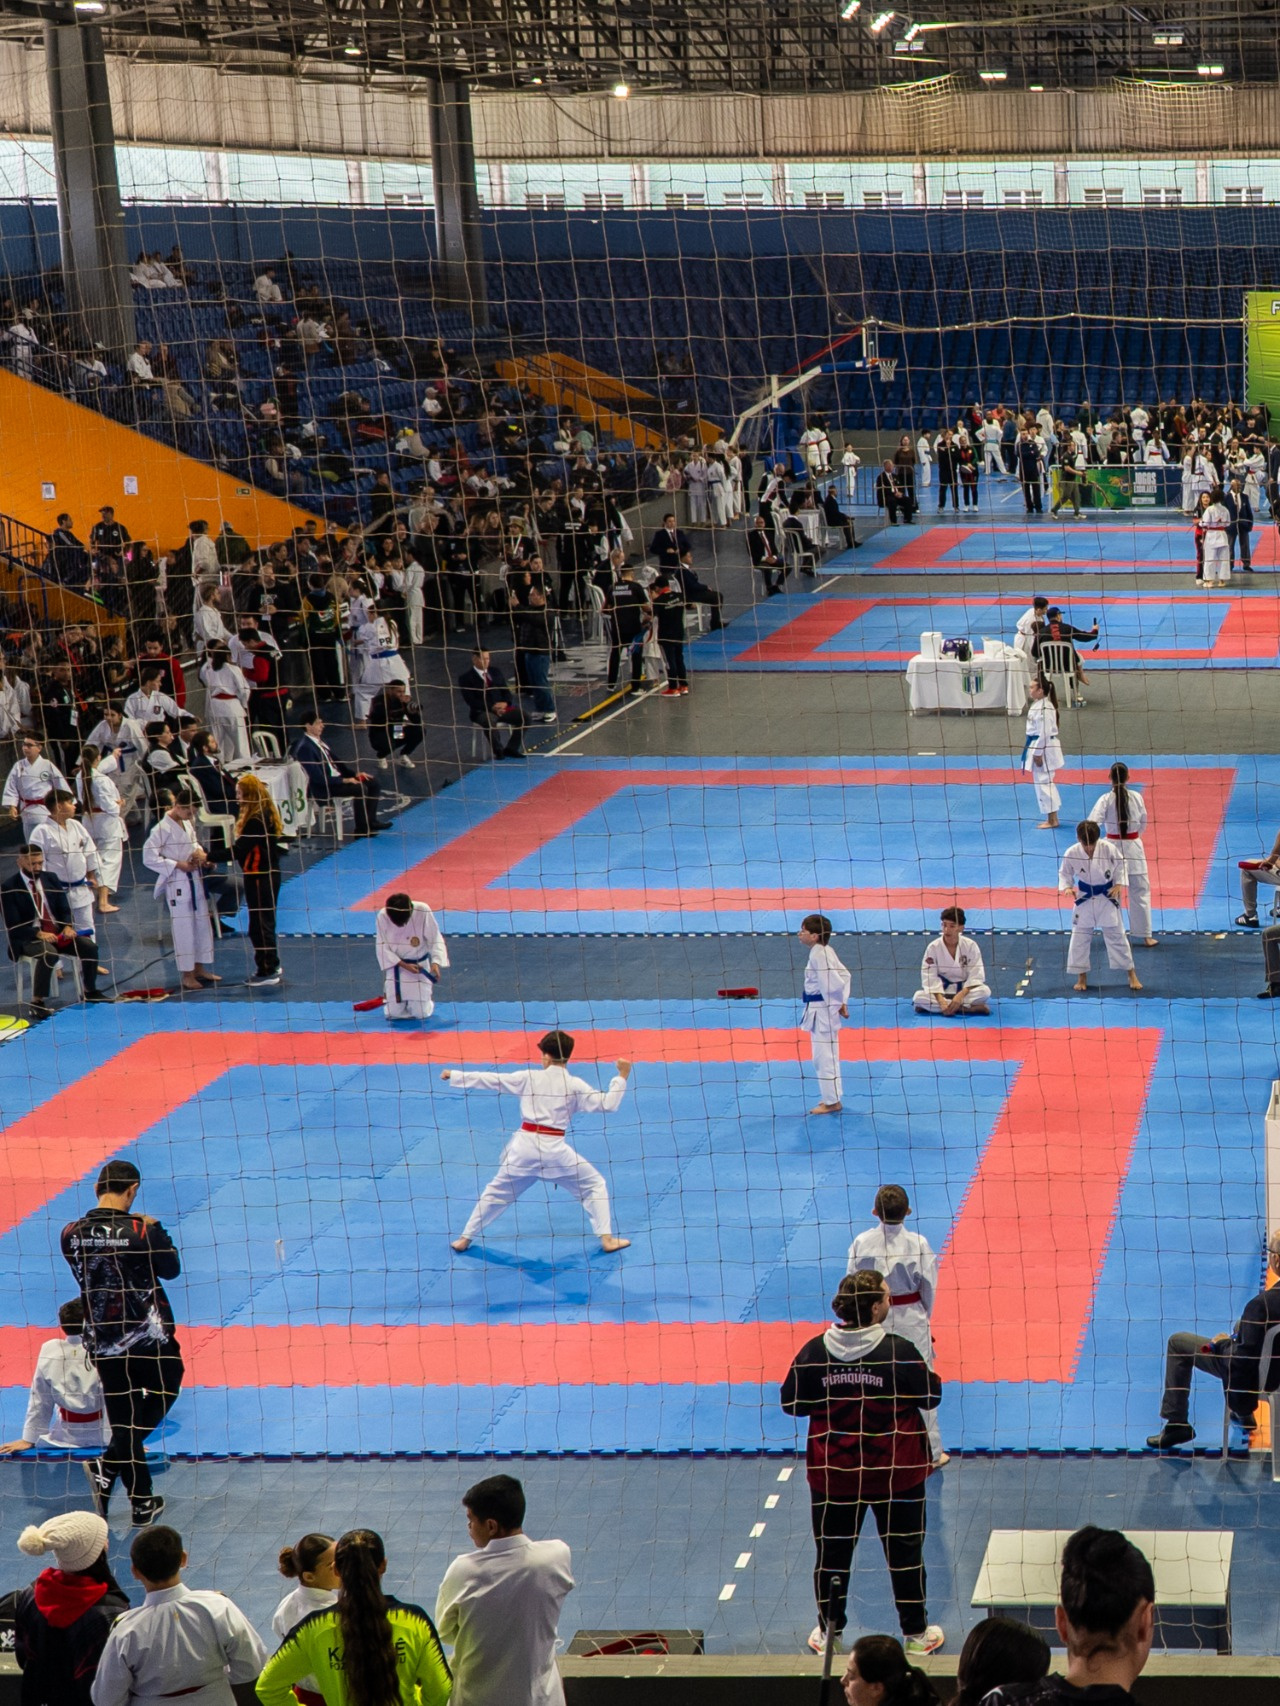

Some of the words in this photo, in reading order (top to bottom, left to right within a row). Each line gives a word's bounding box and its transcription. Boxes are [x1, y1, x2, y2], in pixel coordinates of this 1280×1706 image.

[378, 637, 393, 646] PR
[106, 1238, 130, 1247] PINHAIS
[821, 1372, 884, 1388] PIRAQUARA
